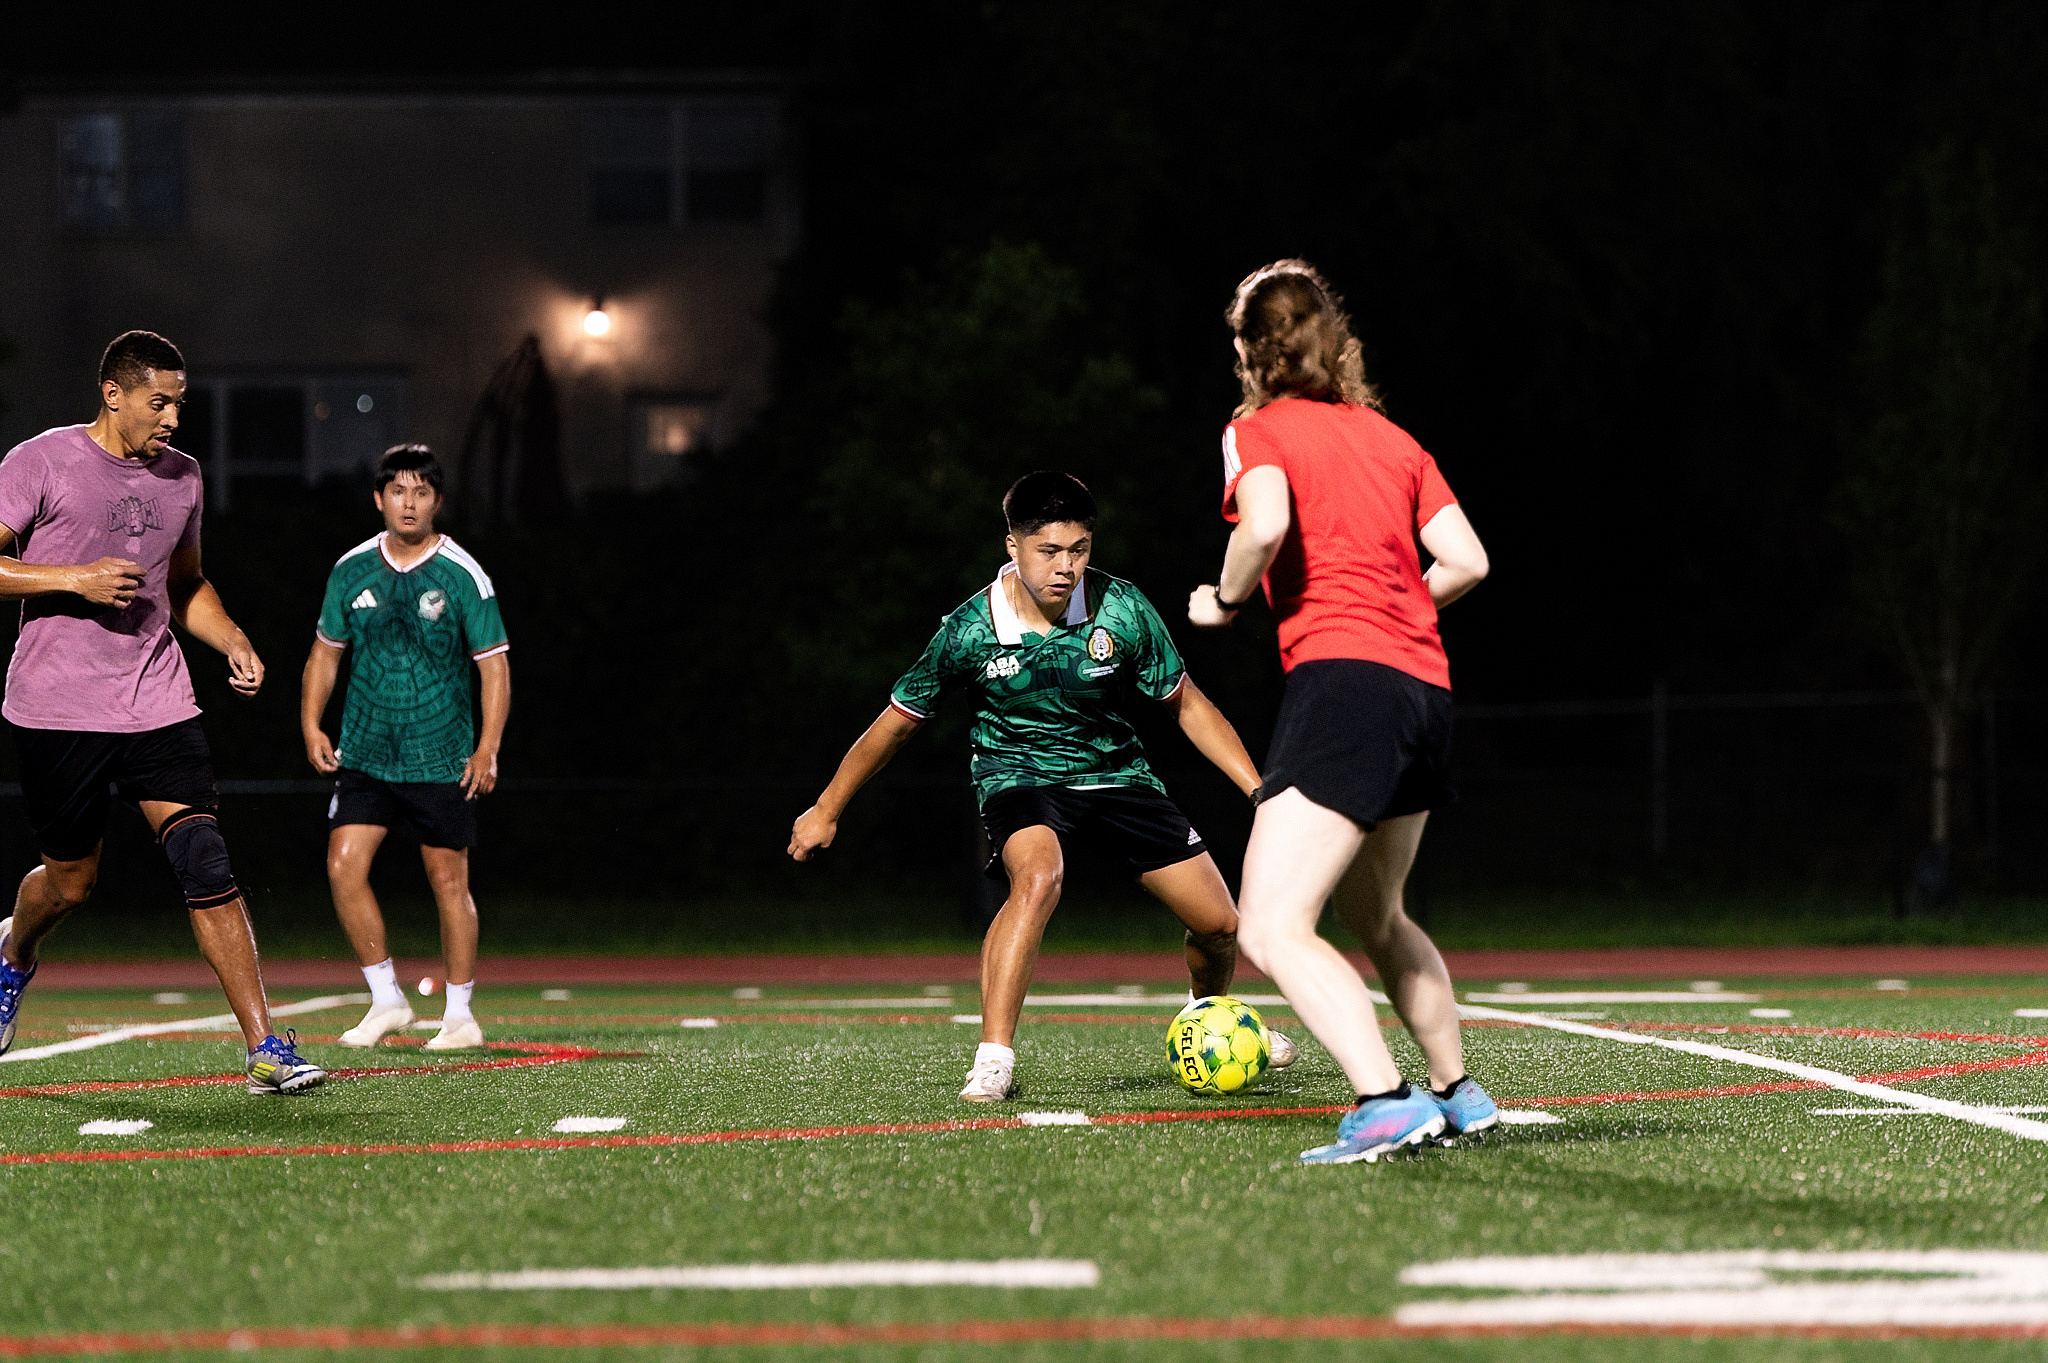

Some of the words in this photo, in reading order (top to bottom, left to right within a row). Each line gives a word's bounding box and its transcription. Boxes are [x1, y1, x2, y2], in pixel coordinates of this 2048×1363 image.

[986, 655, 1020, 671] ABA
[986, 666, 1022, 679] SPORT
[1181, 1026, 1203, 1082] SELECT
